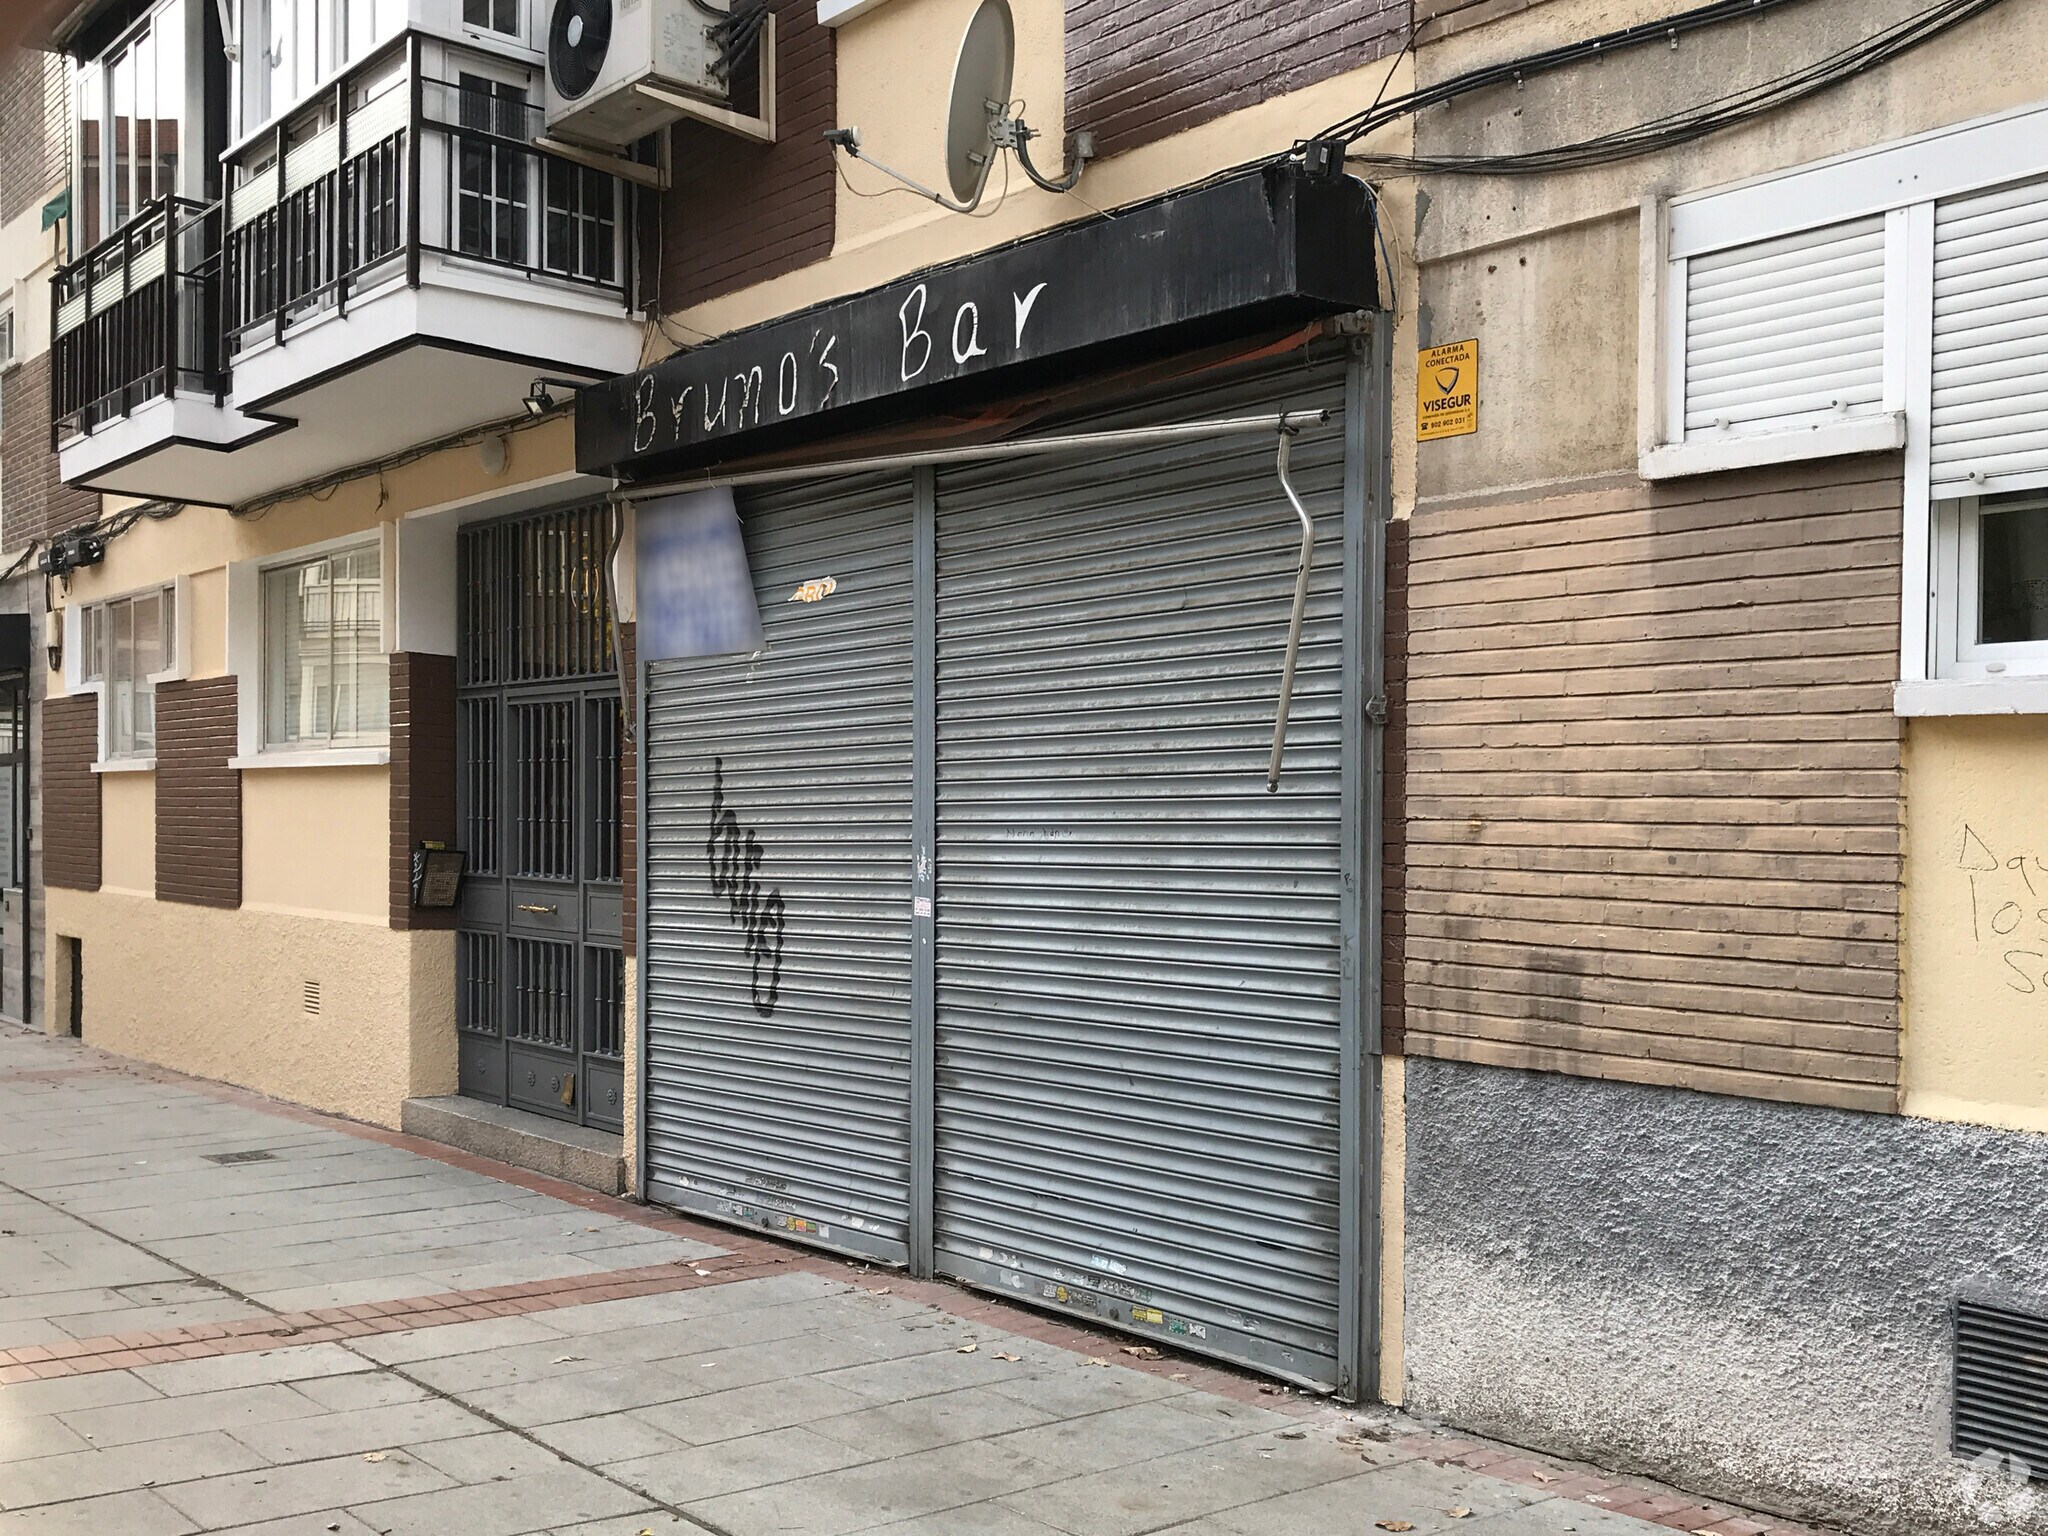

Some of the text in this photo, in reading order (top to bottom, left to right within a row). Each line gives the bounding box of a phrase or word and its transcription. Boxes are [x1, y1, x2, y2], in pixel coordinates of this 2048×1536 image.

[1431, 344, 1464, 358] ALARMA
[633, 282, 1048, 453] Bruno's Bar
[1425, 352, 1470, 368] CONECTADA
[1423, 393, 1471, 412] VISEGUR
